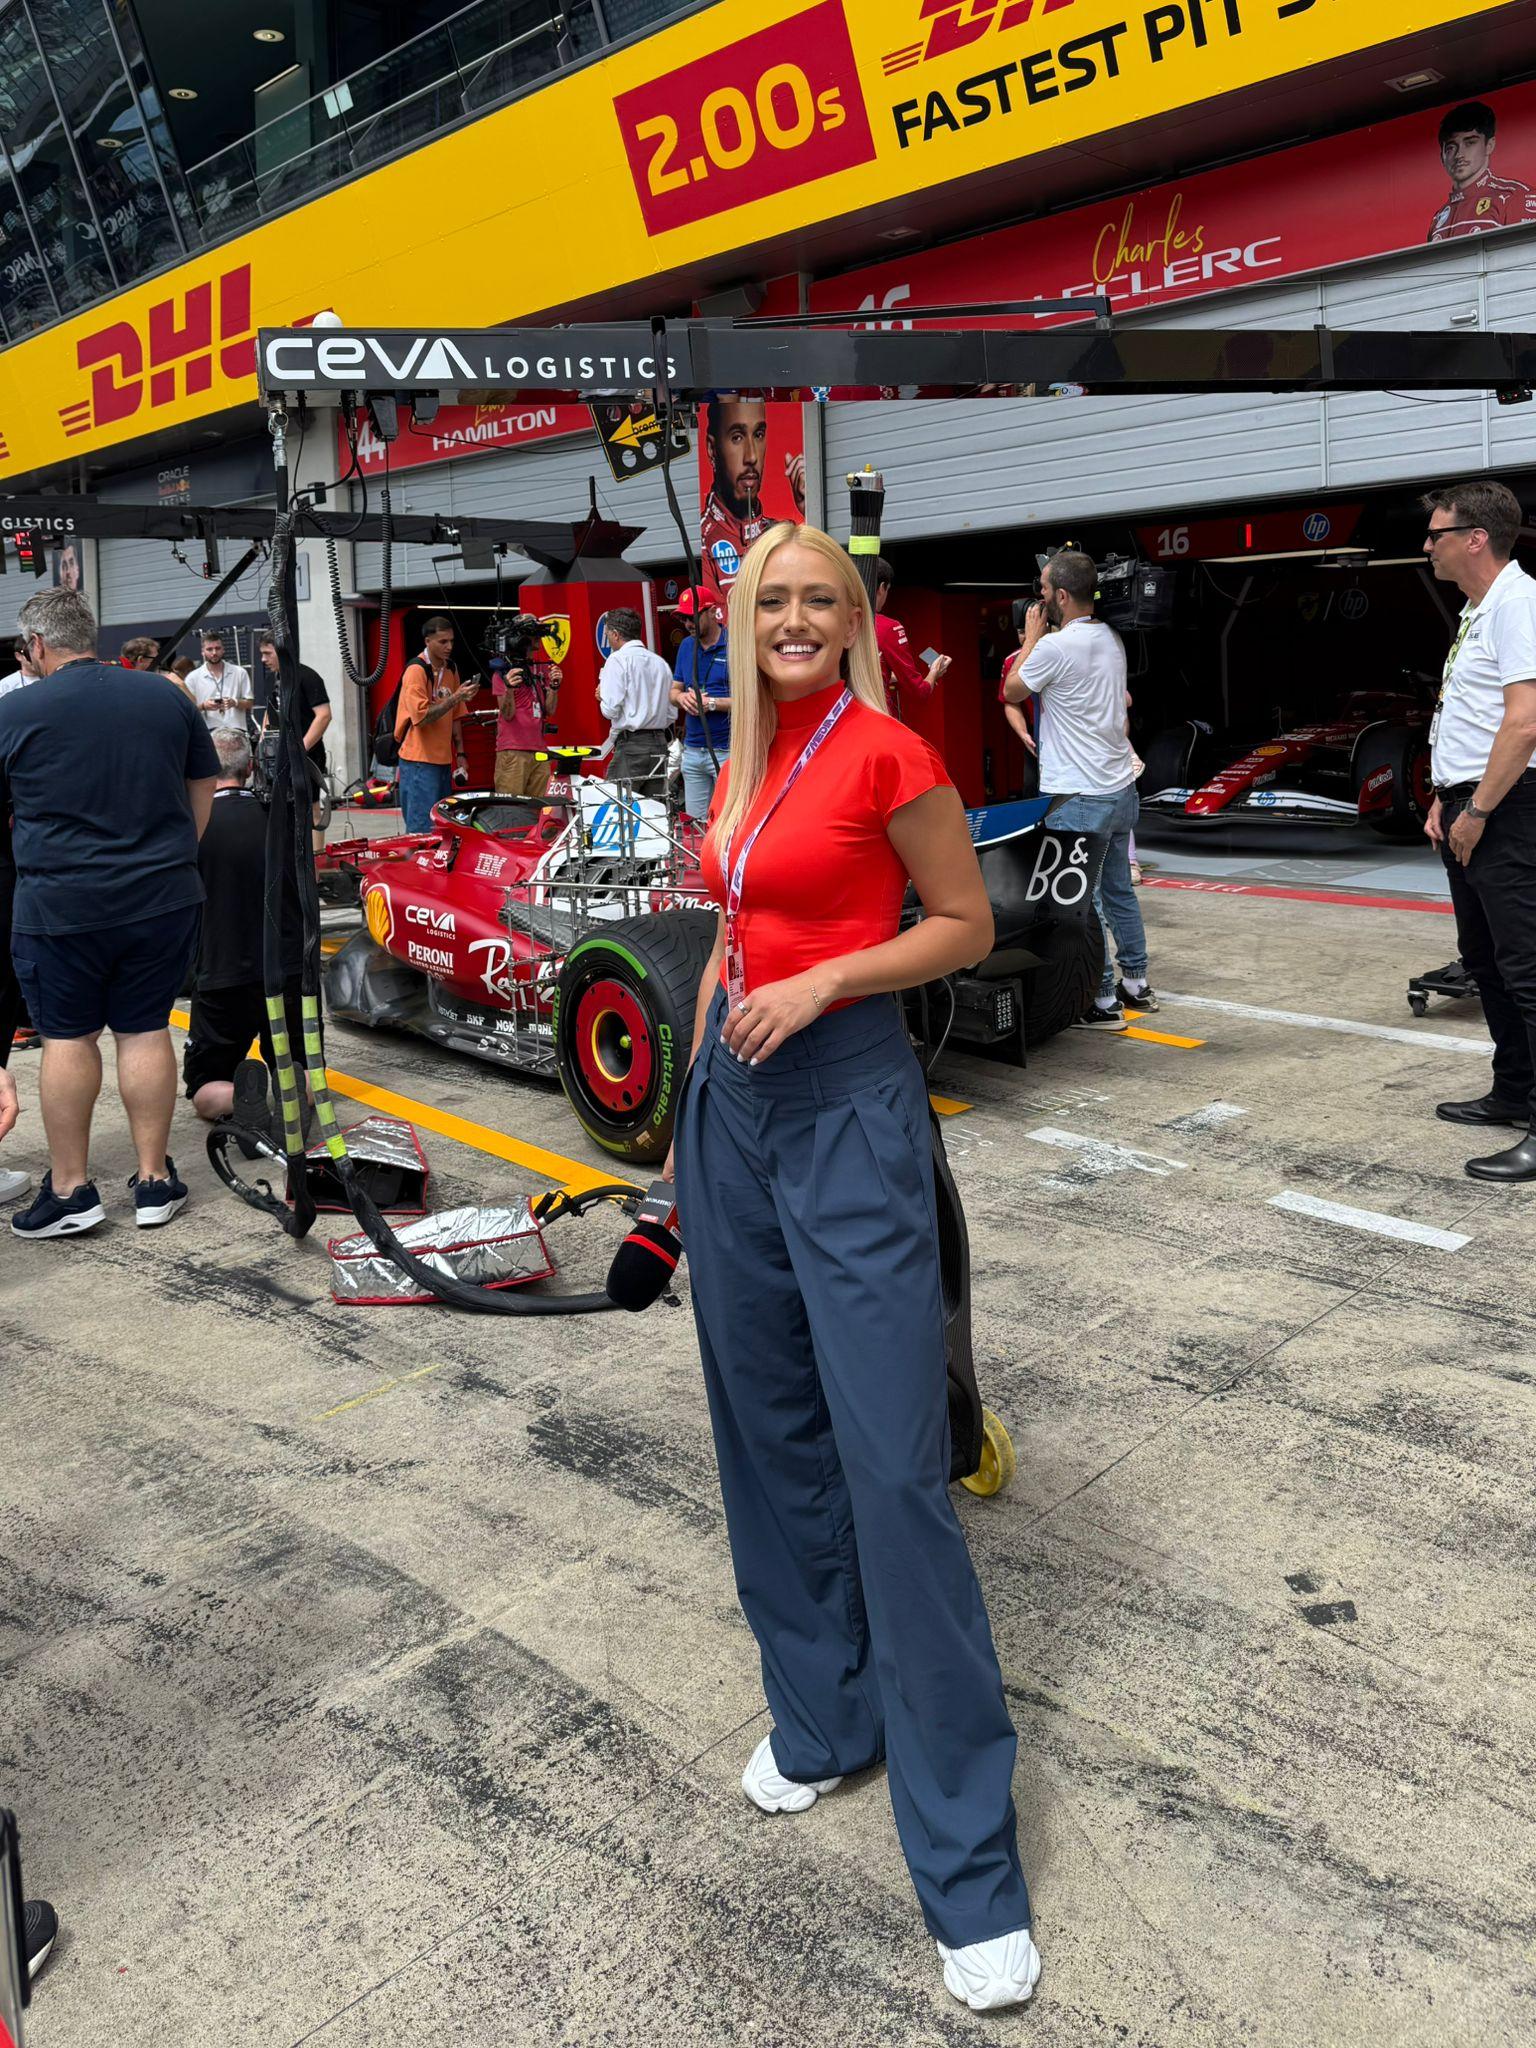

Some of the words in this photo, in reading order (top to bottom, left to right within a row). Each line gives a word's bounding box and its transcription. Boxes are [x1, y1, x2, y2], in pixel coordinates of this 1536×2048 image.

[892, 21, 1127, 149] FASTEST
[634, 63, 846, 197] 2.00s
[1093, 193, 1204, 283] Charles
[77, 263, 257, 428] DHL
[486, 356, 677, 379] LOGISTICS
[357, 420, 387, 464] 44
[433, 406, 557, 452] HAMILTON
[158, 465, 190, 483] ORACLE
[1158, 526, 1190, 556] 16
[1304, 513, 1329, 541] hp
[713, 541, 738, 575] hp
[547, 782, 568, 795] ZCG
[474, 852, 508, 878] IBM
[426, 928, 456, 941] LOGISTICS
[408, 940, 454, 968] PERONI
[466, 1014, 486, 1027] SKF
[495, 1019, 515, 1033] NGK
[653, 1023, 674, 1126] Cinturato
